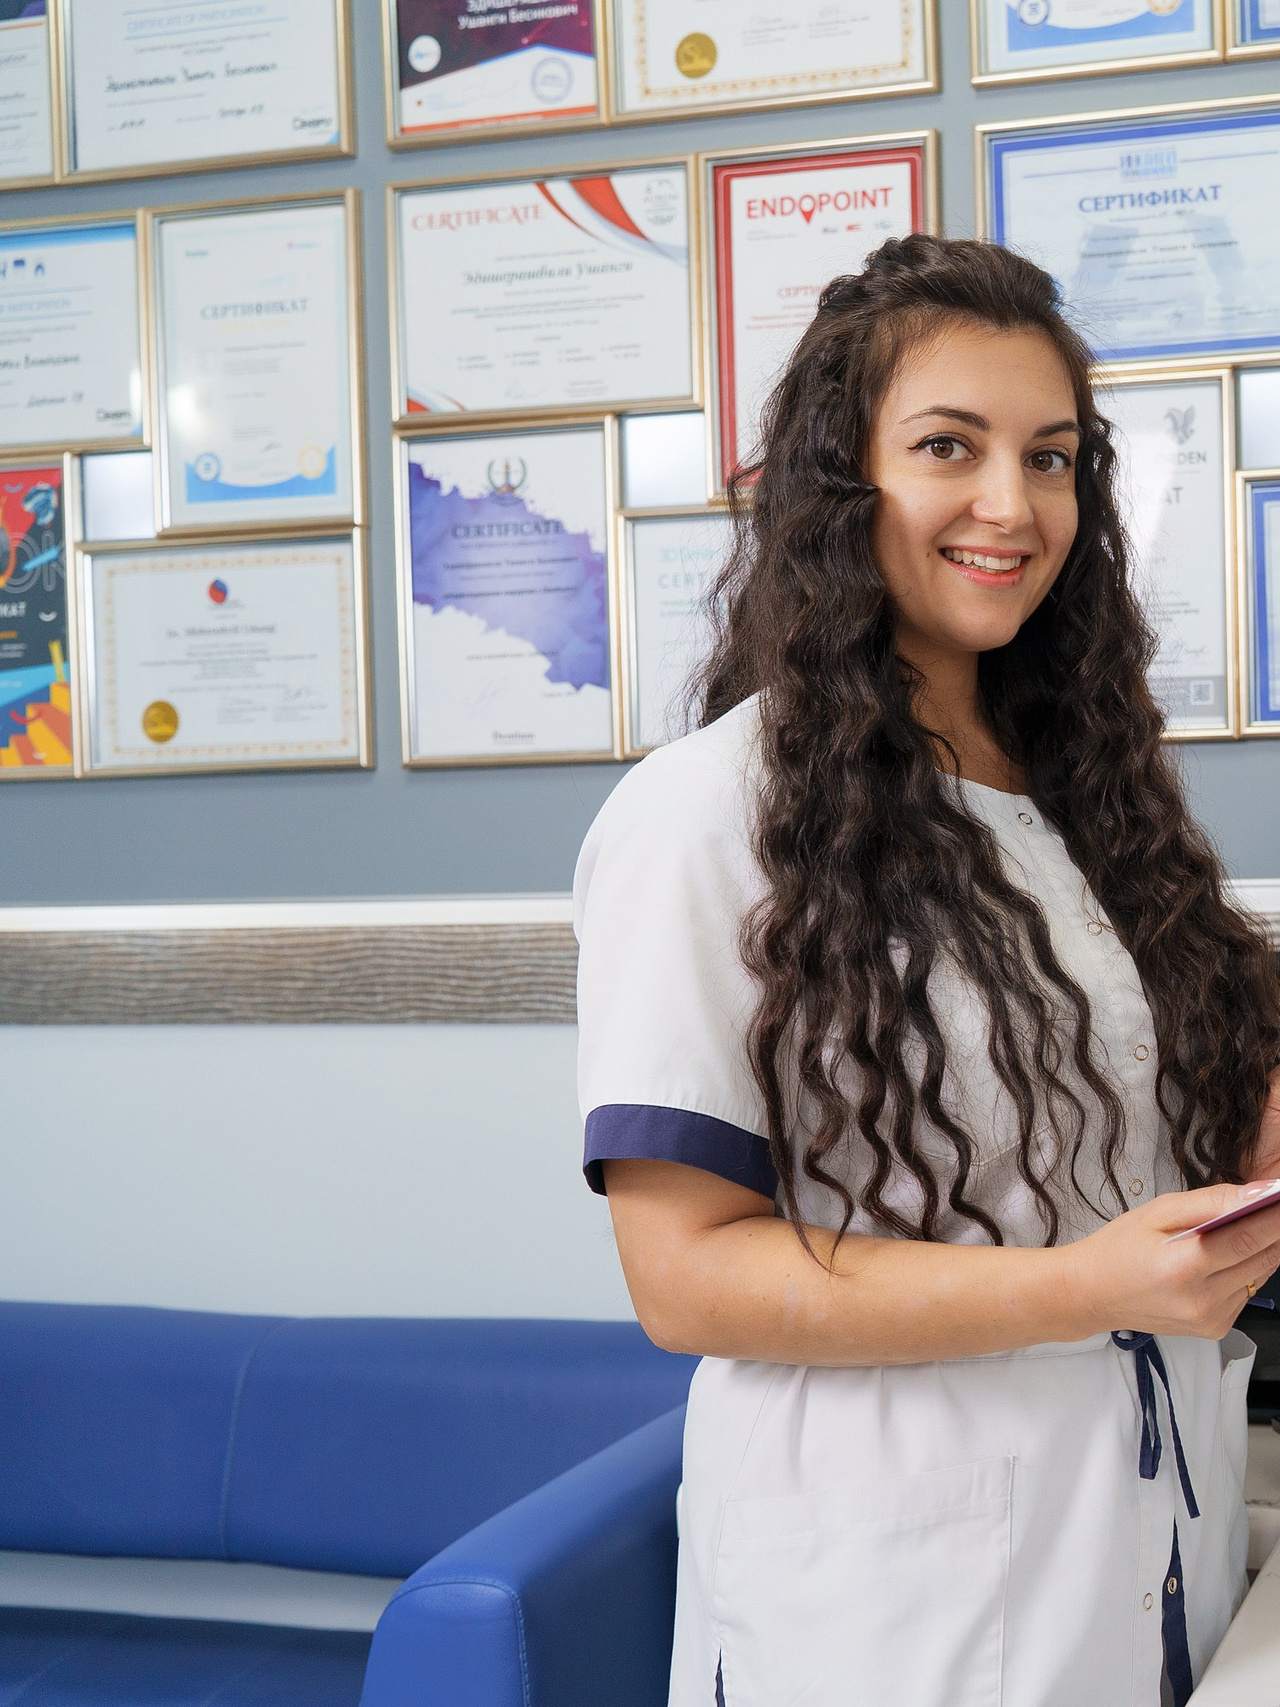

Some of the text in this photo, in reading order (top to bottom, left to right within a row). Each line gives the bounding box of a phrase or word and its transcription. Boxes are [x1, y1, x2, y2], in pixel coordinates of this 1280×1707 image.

[458, 16, 507, 30] Ушанги
[508, 5, 578, 24] Бесикович
[746, 187, 893, 224] ENDOPOINT
[1078, 184, 1222, 214] СЕРТИФИКАТ
[411, 204, 544, 232] CERTIFICATE
[576, 261, 633, 280] Ушанги
[200, 297, 309, 321] СЕРТИФИКАТ
[450, 519, 566, 540] CERTIFICATE
